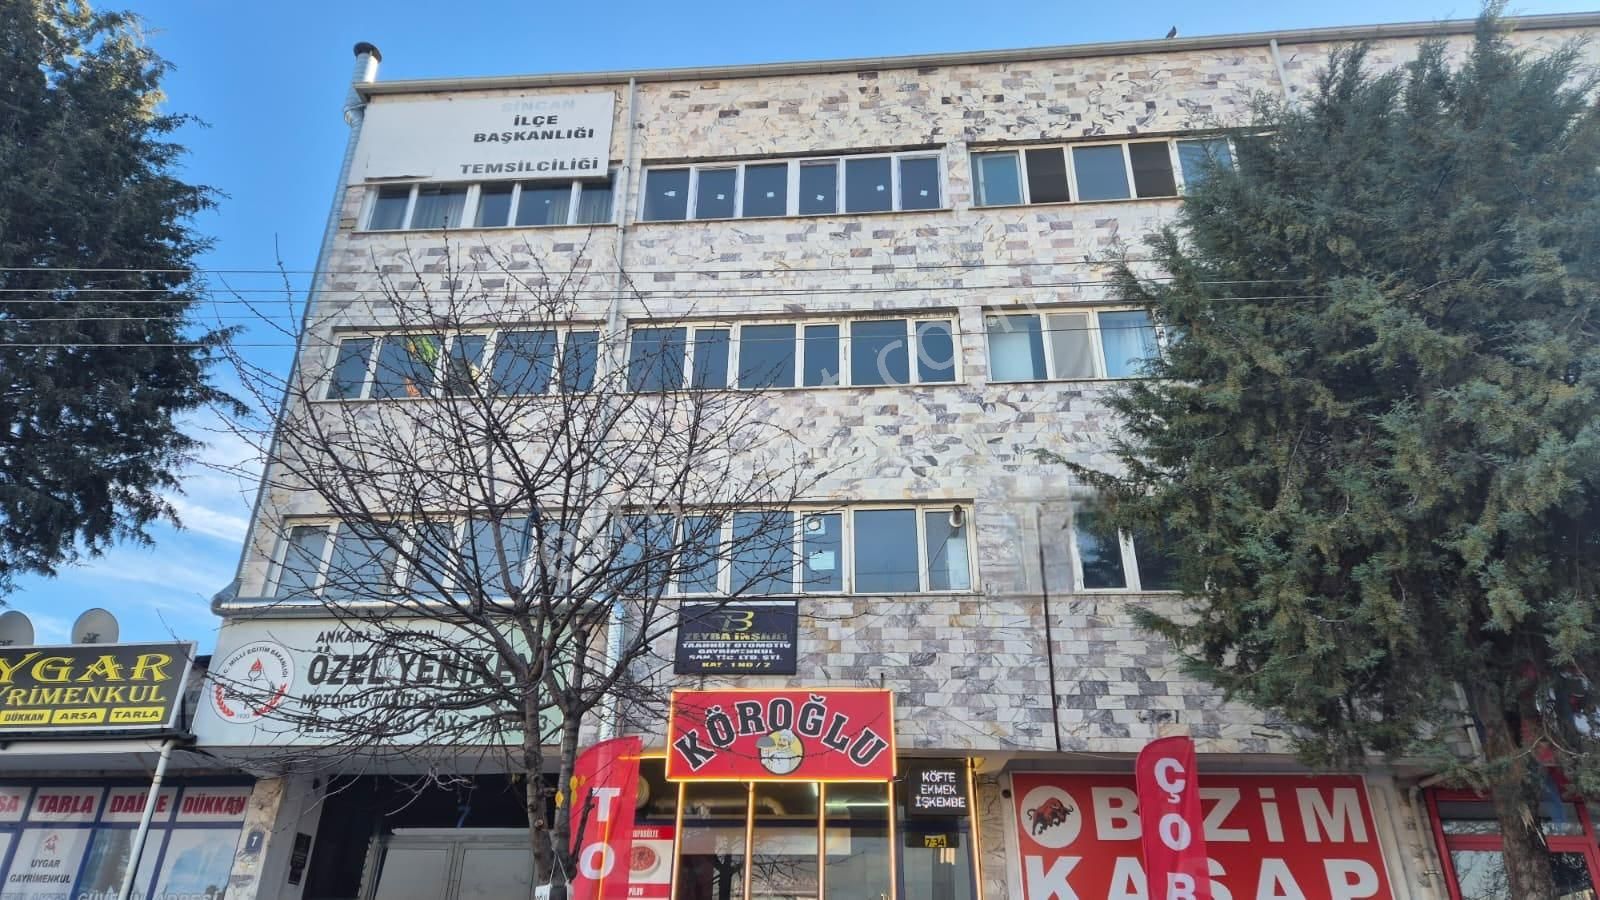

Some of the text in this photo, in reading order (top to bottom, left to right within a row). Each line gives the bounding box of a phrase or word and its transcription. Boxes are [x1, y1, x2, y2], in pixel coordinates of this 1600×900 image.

[513, 114, 558, 127] İLÇE
[473, 127, 594, 144] BAŞKANLIĞI
[460, 157, 599, 174] TEMSİLCİLİĞİ
[316, 631, 372, 643] ANKARA
[308, 646, 394, 686] ÖZEL
[4, 710, 160, 722] DÜKKAN ARSA TARLA
[674, 693, 889, 772] KÖROĞLU
[921, 769, 957, 783] KÖFTE
[920, 784, 957, 795] EKMEK
[37, 795, 96, 813] TARLA
[109, 791, 169, 813] DAİE
[182, 793, 246, 814] DÜKKAN
[914, 794, 967, 809] İŞKEMBE
[1090, 786, 1369, 843] BZİM
[30, 859, 61, 868] UYGAR
[9, 874, 72, 884] GAYRİMENKUL
